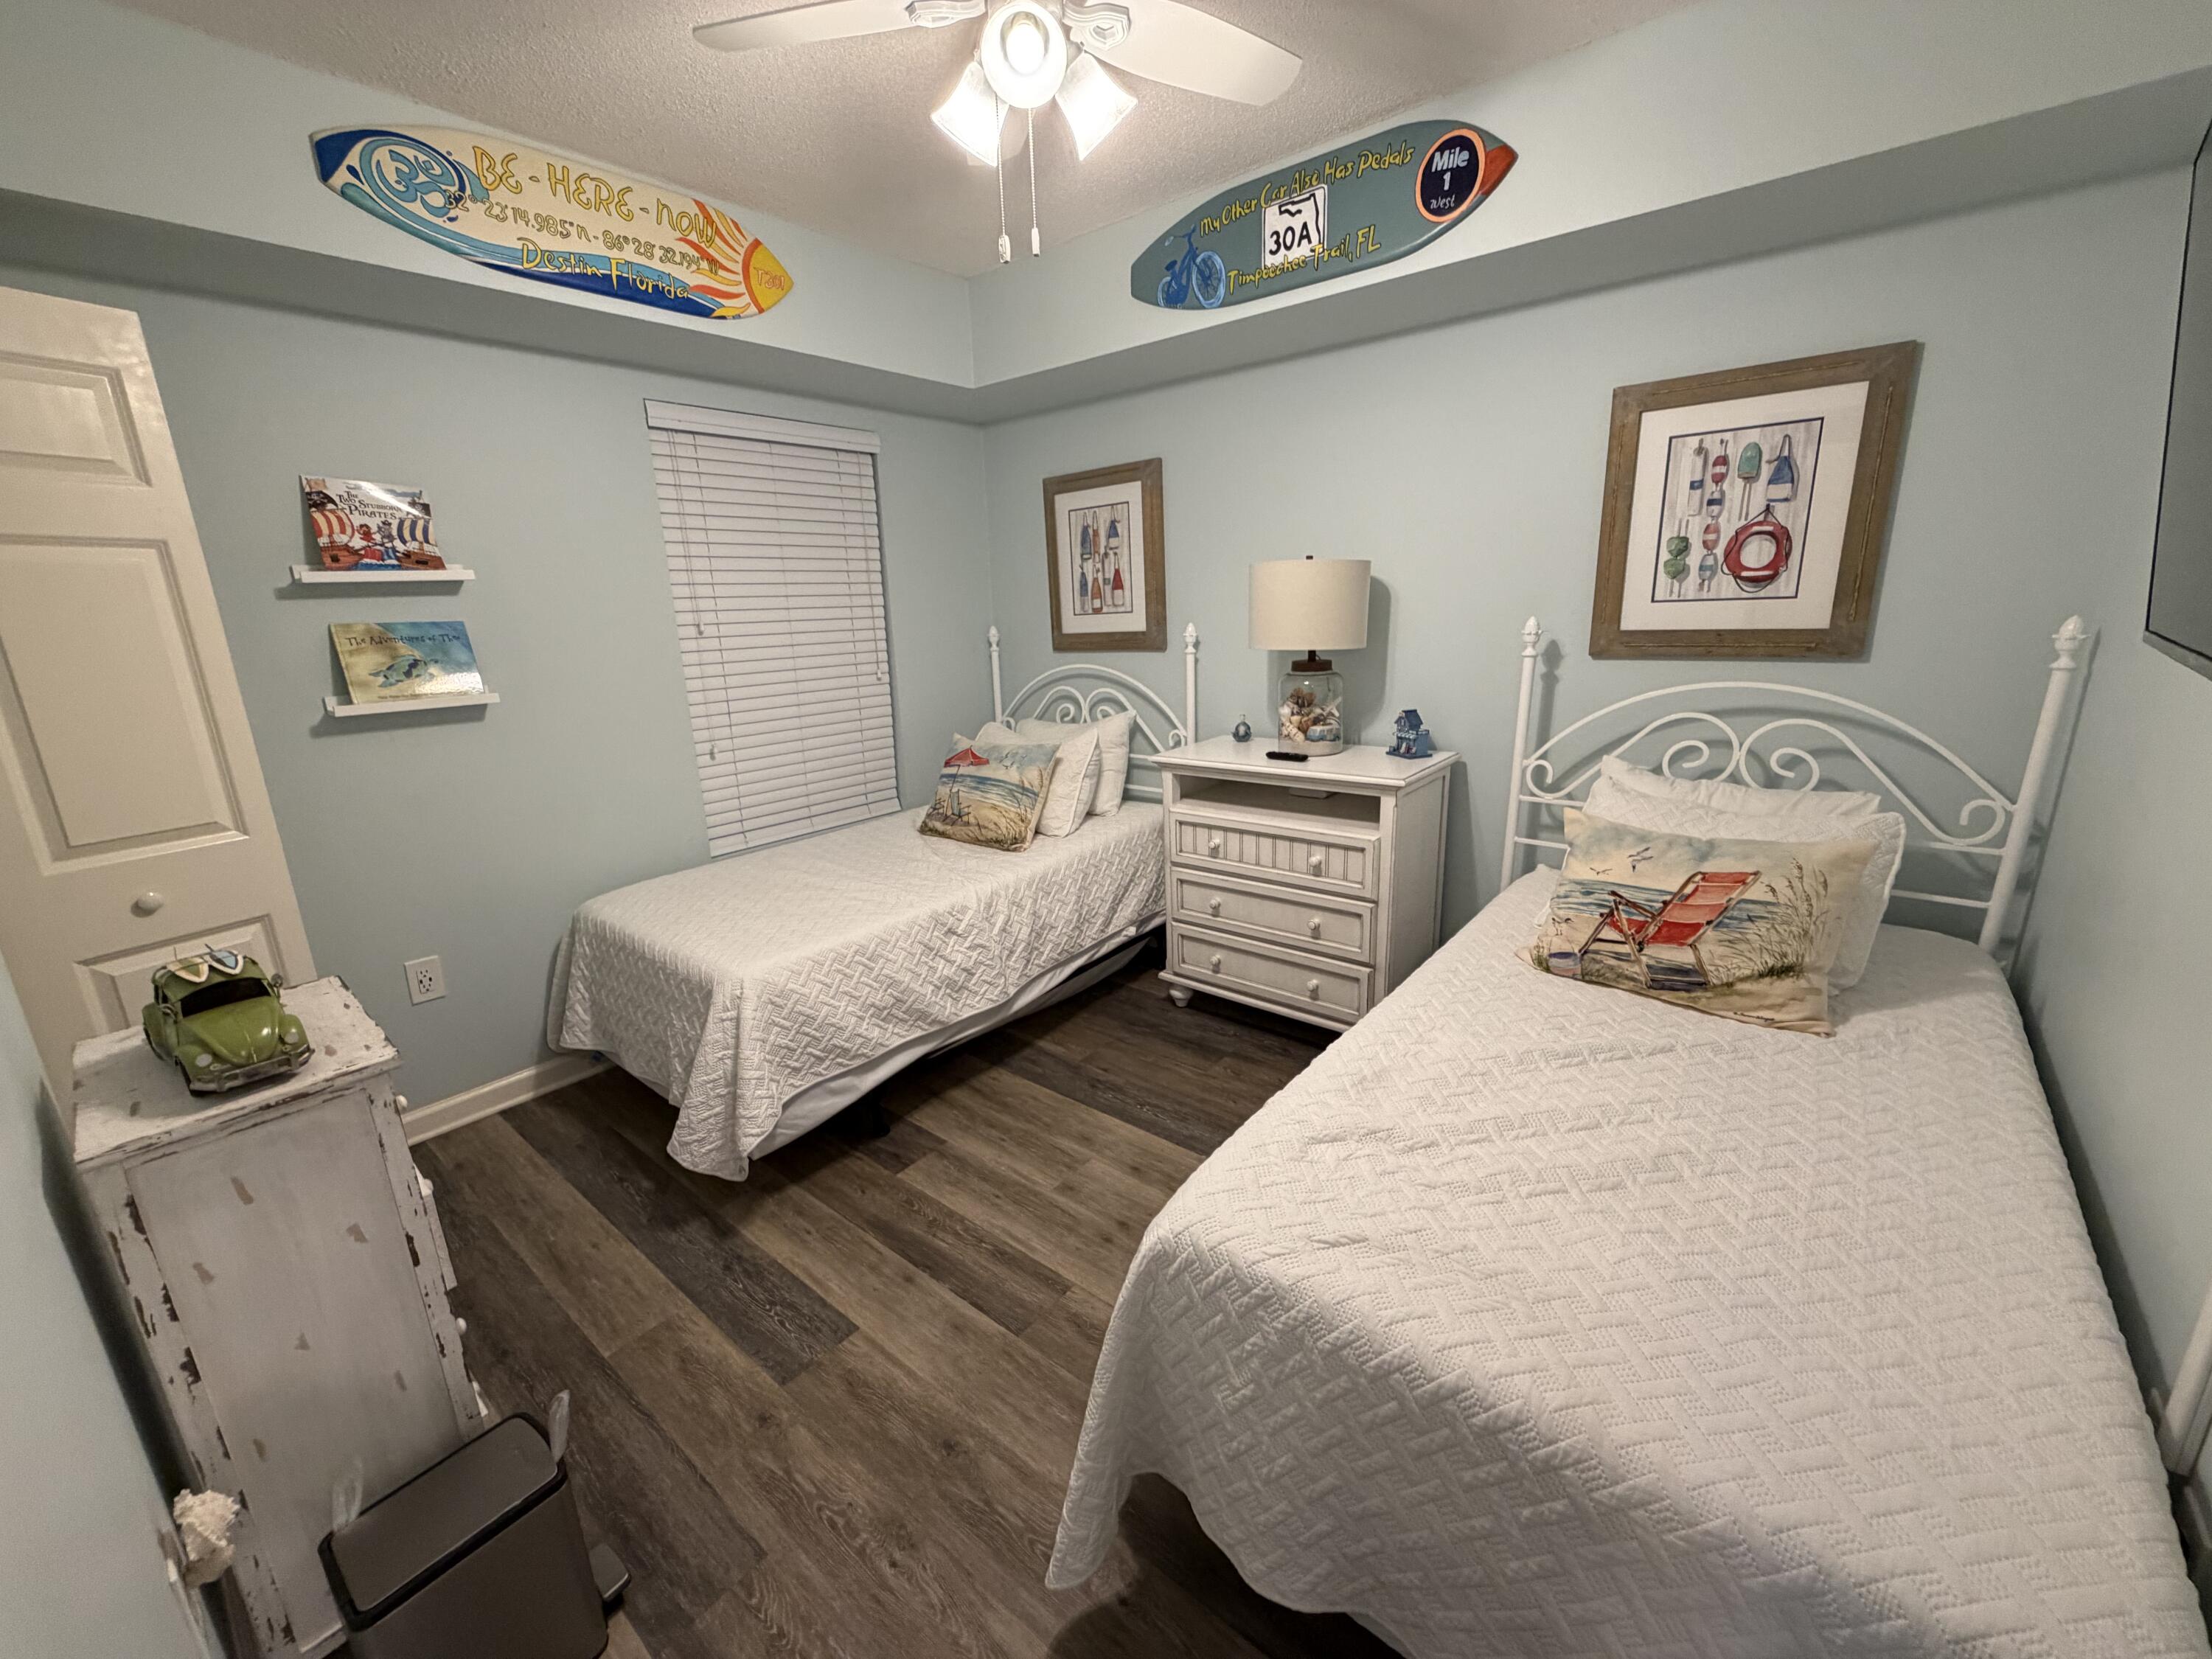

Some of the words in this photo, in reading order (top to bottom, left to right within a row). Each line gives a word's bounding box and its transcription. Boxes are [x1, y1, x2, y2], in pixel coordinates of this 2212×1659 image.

[1431, 147, 1470, 173] Mile
[472, 146, 523, 195] BE
[547, 162, 634, 222] HERE
[1200, 215, 1220, 237] My
[1222, 198, 1259, 225] Other
[1260, 182, 1287, 209] Car
[1290, 170, 1320, 196] Also
[1324, 156, 1355, 184] Has
[1357, 142, 1415, 178] Pedals
[1443, 171, 1451, 190] 1
[1268, 221, 1312, 256] 30A
[1356, 224, 1381, 258] FL
[517, 237, 602, 278] Destin
[611, 257, 690, 299] Florida
[345, 636, 366, 647] The
[369, 634, 425, 646] Adventures
